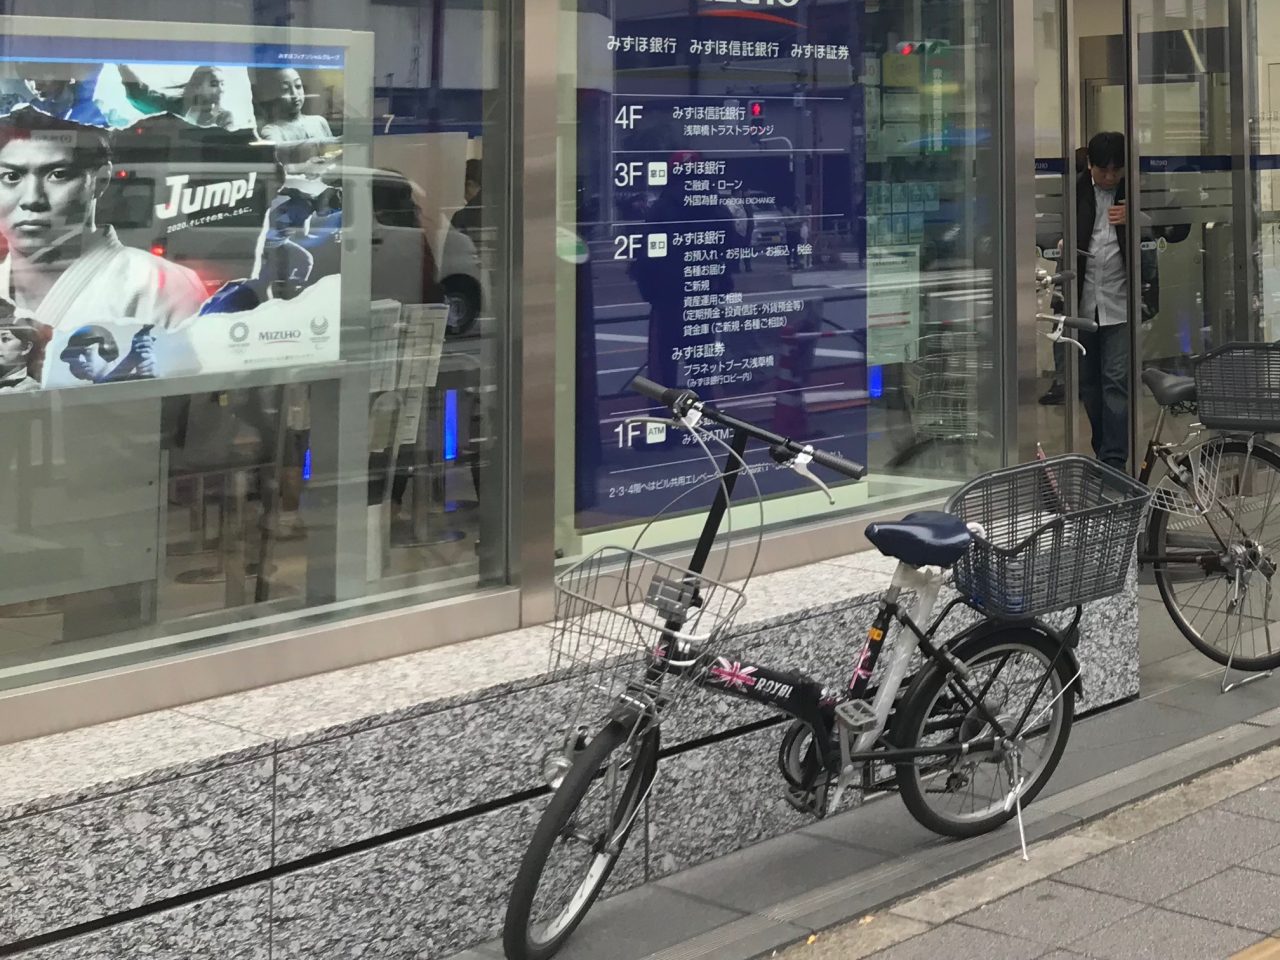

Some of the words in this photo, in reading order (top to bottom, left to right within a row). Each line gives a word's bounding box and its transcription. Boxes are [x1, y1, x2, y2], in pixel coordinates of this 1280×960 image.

[606, 35, 677, 54] みずほ銀行
[690, 40, 779, 58] みずほ信託銀行
[791, 43, 849, 60] みずほ証券
[382, 114, 394, 134] 7
[614, 105, 643, 130] 4F
[673, 106, 746, 121] みずほ信託銀行
[684, 125, 774, 136] 浅草橋トラストラウンジ
[614, 162, 643, 187] 3F
[673, 161, 726, 175] みずほ銀行
[155, 172, 257, 219] Jump!
[684, 195, 718, 206] 外国為替
[614, 234, 643, 260] 2F
[672, 230, 725, 246] みずほ銀行
[683, 264, 726, 277] 各種お届け
[684, 280, 710, 292] ご新規
[683, 292, 743, 307] 資産運用ご相談
[258, 329, 301, 341] MIZUHO
[672, 341, 725, 360] みずほ証券
[614, 422, 641, 448] 1F
[648, 426, 665, 437] ATM
[754, 677, 794, 699] ROYAL
